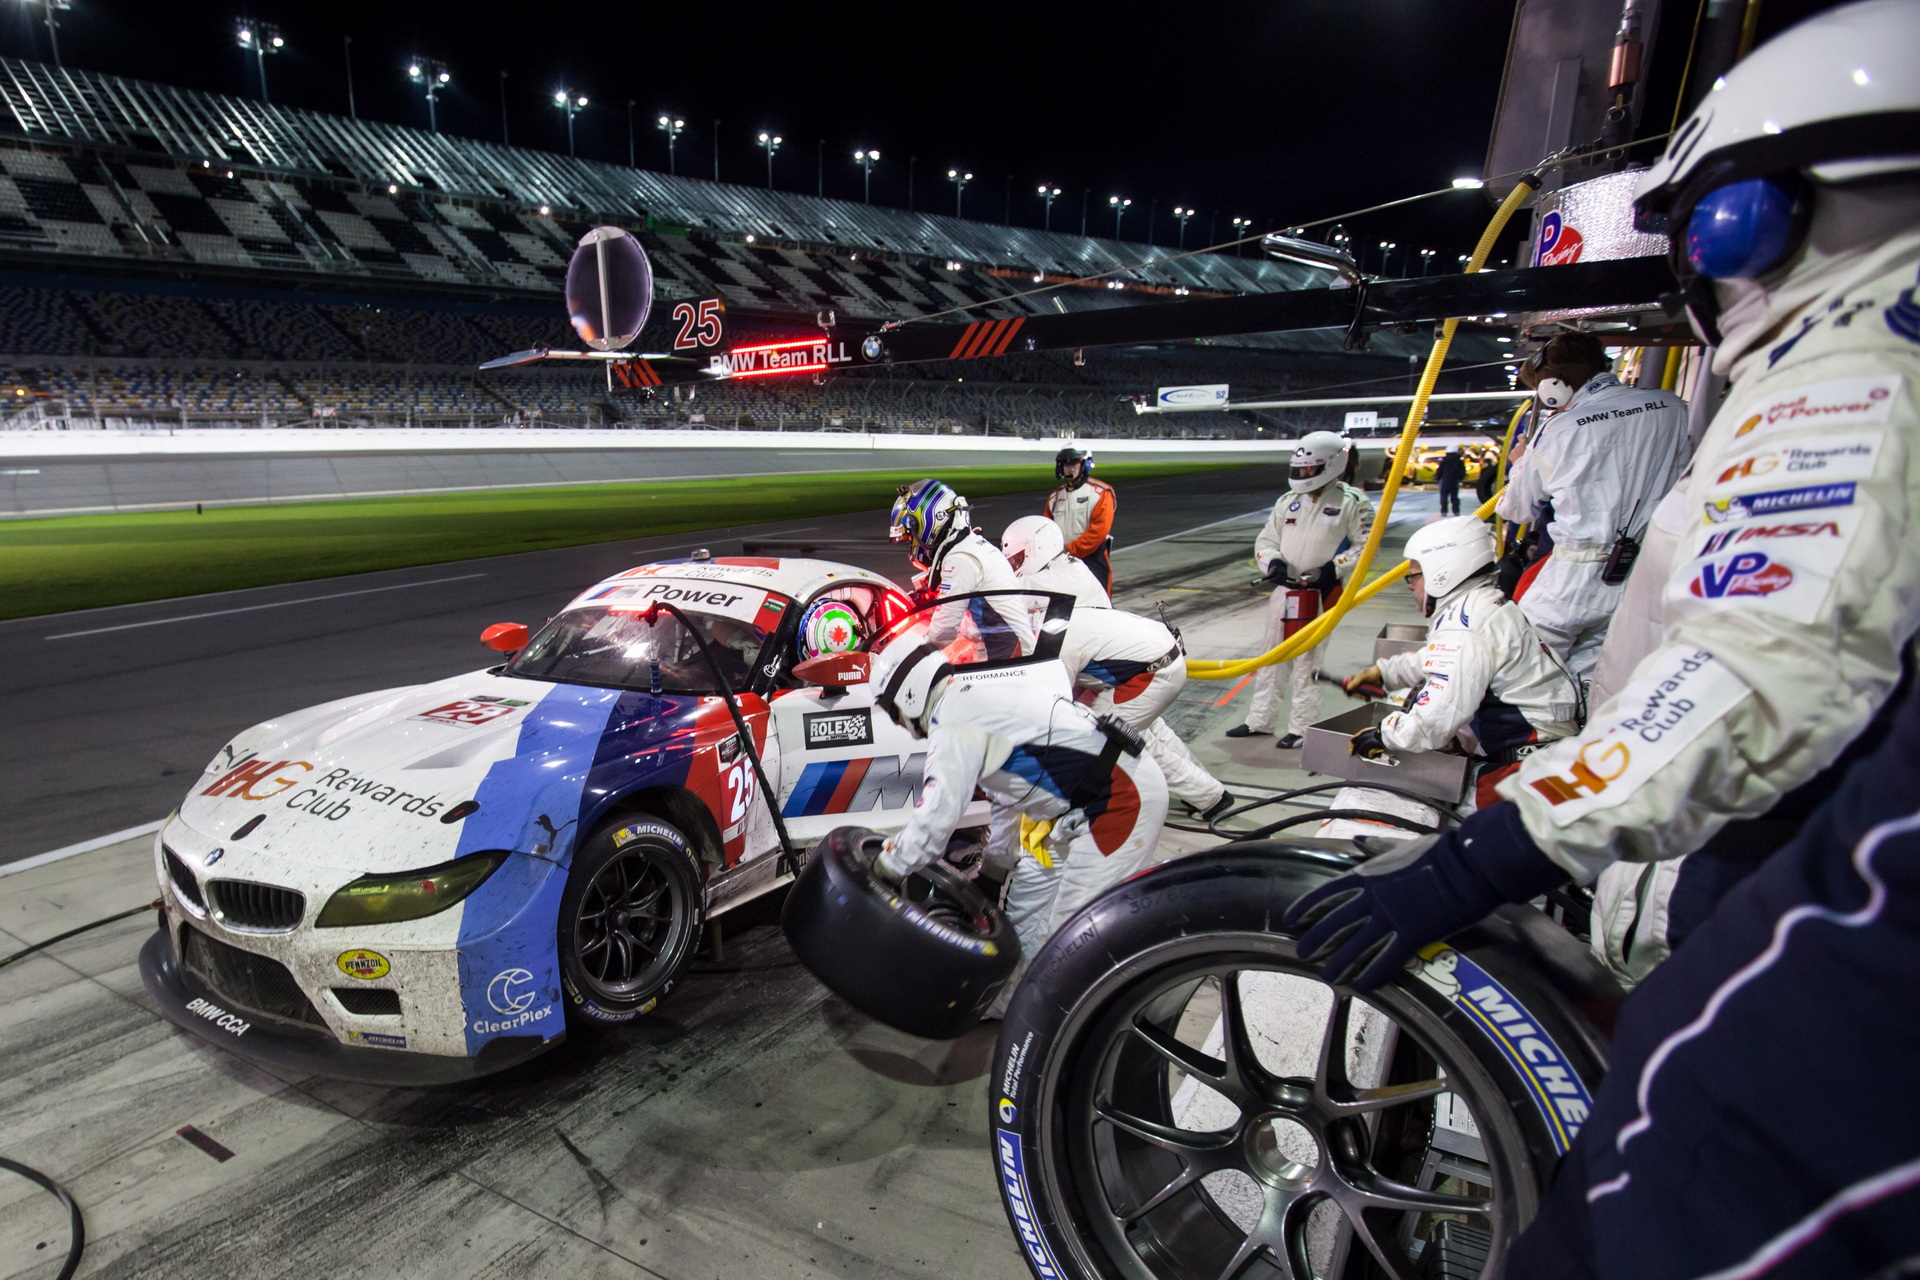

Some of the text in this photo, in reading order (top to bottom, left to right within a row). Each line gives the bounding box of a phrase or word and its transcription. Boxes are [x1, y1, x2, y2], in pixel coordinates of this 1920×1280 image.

[672, 298, 723, 350] 25
[710, 341, 852, 377] BMW Team RLL
[1215, 390, 1227, 399] 52
[1353, 417, 1370, 425] 911
[1576, 400, 1669, 426] BMW Team RLL
[1767, 402, 1873, 425] V-Power
[1789, 444, 1872, 460] Rewards
[1787, 460, 1827, 472] Club
[1752, 486, 1853, 508] MICHELIN
[1734, 522, 1842, 544] IMSA
[685, 571, 725, 579] Club
[1702, 552, 1769, 598] VP
[643, 584, 743, 608] Power
[838, 671, 862, 681] PUMA
[961, 669, 1028, 682] RFORMANCE
[1619, 651, 1714, 732] Rewards
[428, 702, 509, 721] 25
[1639, 699, 1696, 743] Club
[810, 720, 867, 740] ROLEX 24
[200, 760, 314, 800] IHG
[845, 752, 928, 813] M
[1529, 738, 1630, 806] IHG
[316, 768, 445, 817] Rewards
[728, 756, 754, 823] 25
[286, 789, 351, 821] Club
[636, 825, 683, 846] MICHELIN
[345, 958, 383, 970] PENNZOIL
[185, 998, 251, 1036] BMW CCA
[473, 1005, 552, 1034] ClearPlex
[583, 1003, 636, 1022] MICHELIN
[367, 1035, 405, 1046] MICHELIN
[1003, 1043, 1020, 1095] MICHELIN
[1010, 1031, 1034, 1099] Total Performance
[1001, 1136, 1056, 1280] ICHELIN
